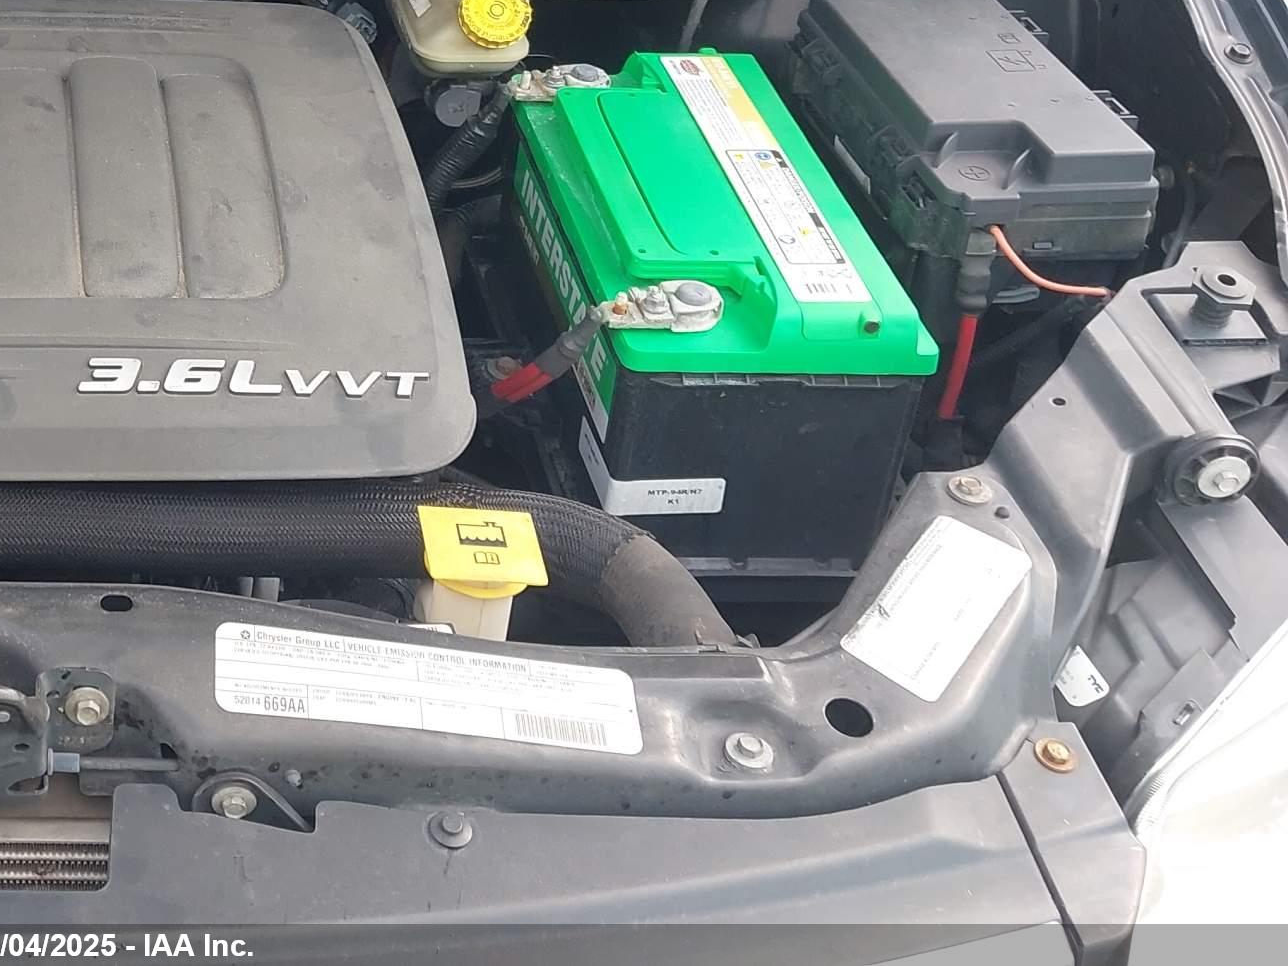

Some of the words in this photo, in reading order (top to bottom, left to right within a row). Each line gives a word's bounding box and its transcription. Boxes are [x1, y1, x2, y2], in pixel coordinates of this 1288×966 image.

[77, 357, 283, 396] 3.6L
[285, 369, 430, 399] VVT
[256, 631, 292, 643] Chrysler
[296, 635, 321, 647] Group
[324, 638, 340, 650] LLC
[347, 642, 381, 654] VEHICLE
[385, 647, 425, 659] EMISSION
[428, 653, 465, 666] CONTROL
[469, 659, 527, 673] INFORMATION
[264, 696, 306, 714] 669AA
